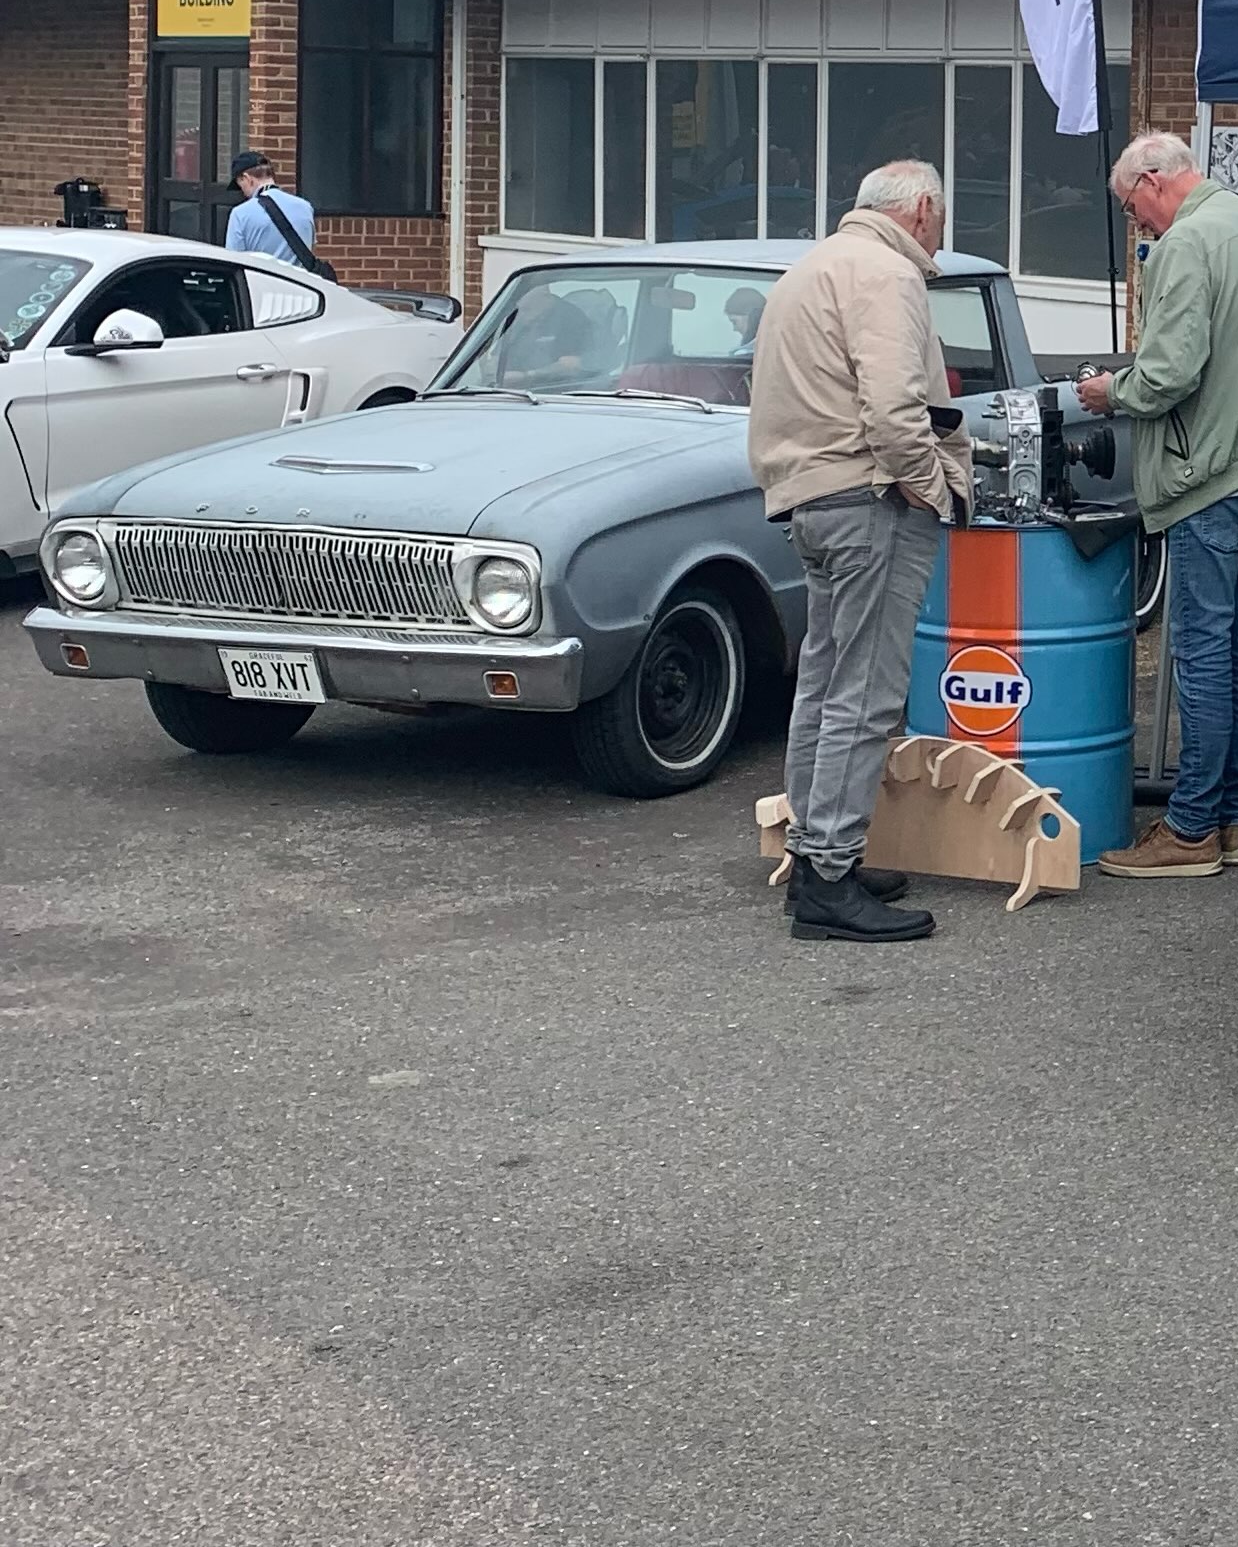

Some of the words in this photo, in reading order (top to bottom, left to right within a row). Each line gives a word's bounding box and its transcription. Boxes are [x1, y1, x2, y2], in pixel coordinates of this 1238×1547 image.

[231, 660, 267, 688] 818
[270, 662, 311, 692] XVT
[944, 675, 1024, 704] Gulf
